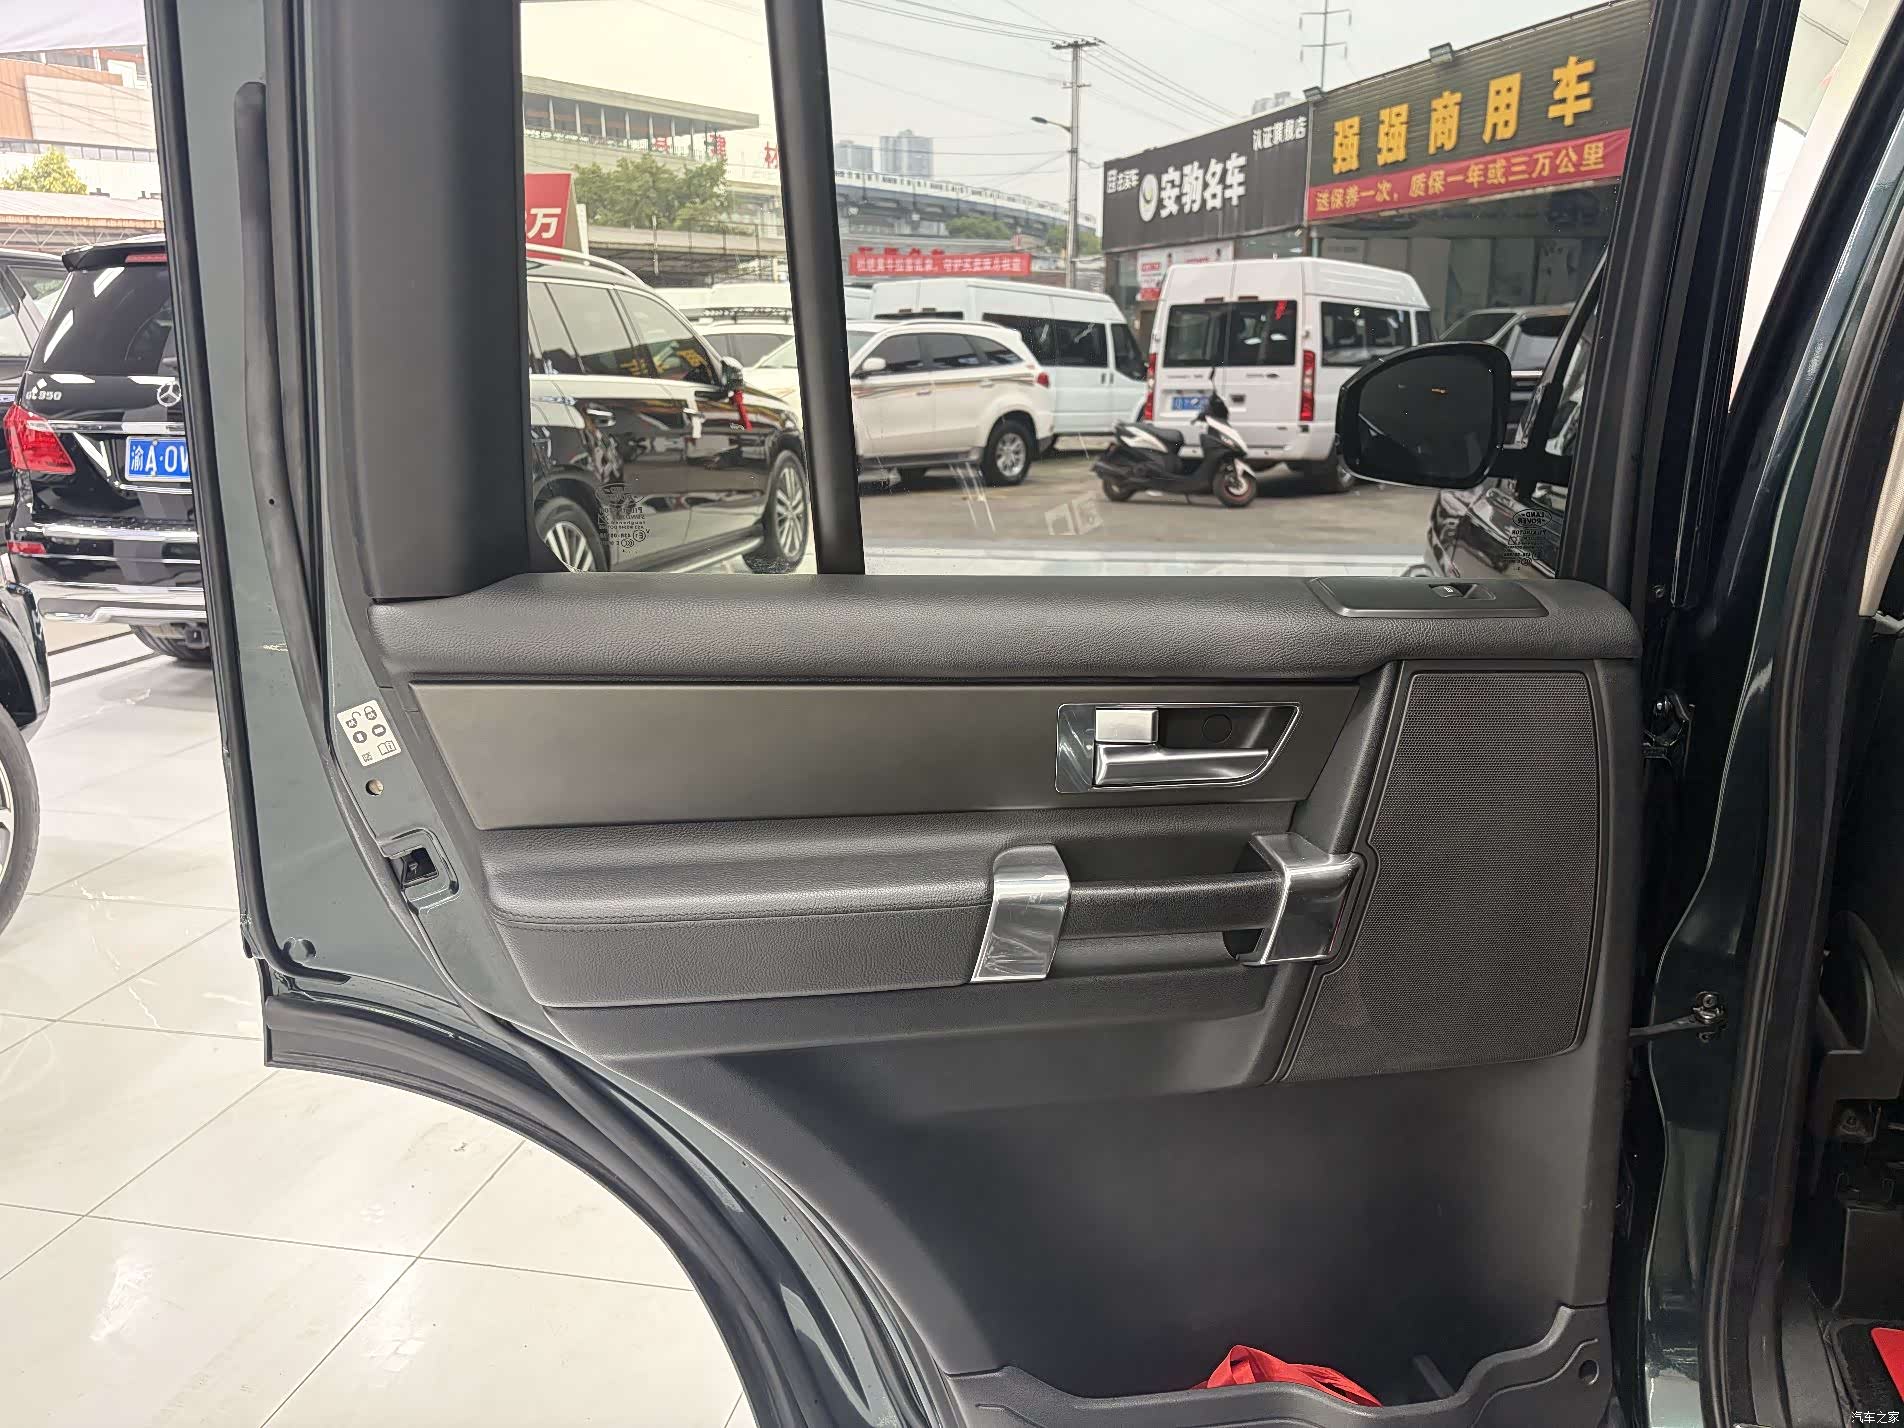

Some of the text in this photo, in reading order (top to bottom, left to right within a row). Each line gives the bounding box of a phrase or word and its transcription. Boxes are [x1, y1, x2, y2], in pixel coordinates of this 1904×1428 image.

[1252, 116, 1307, 151] 认证旗舰店
[1332, 56, 1596, 176] 强强商用车
